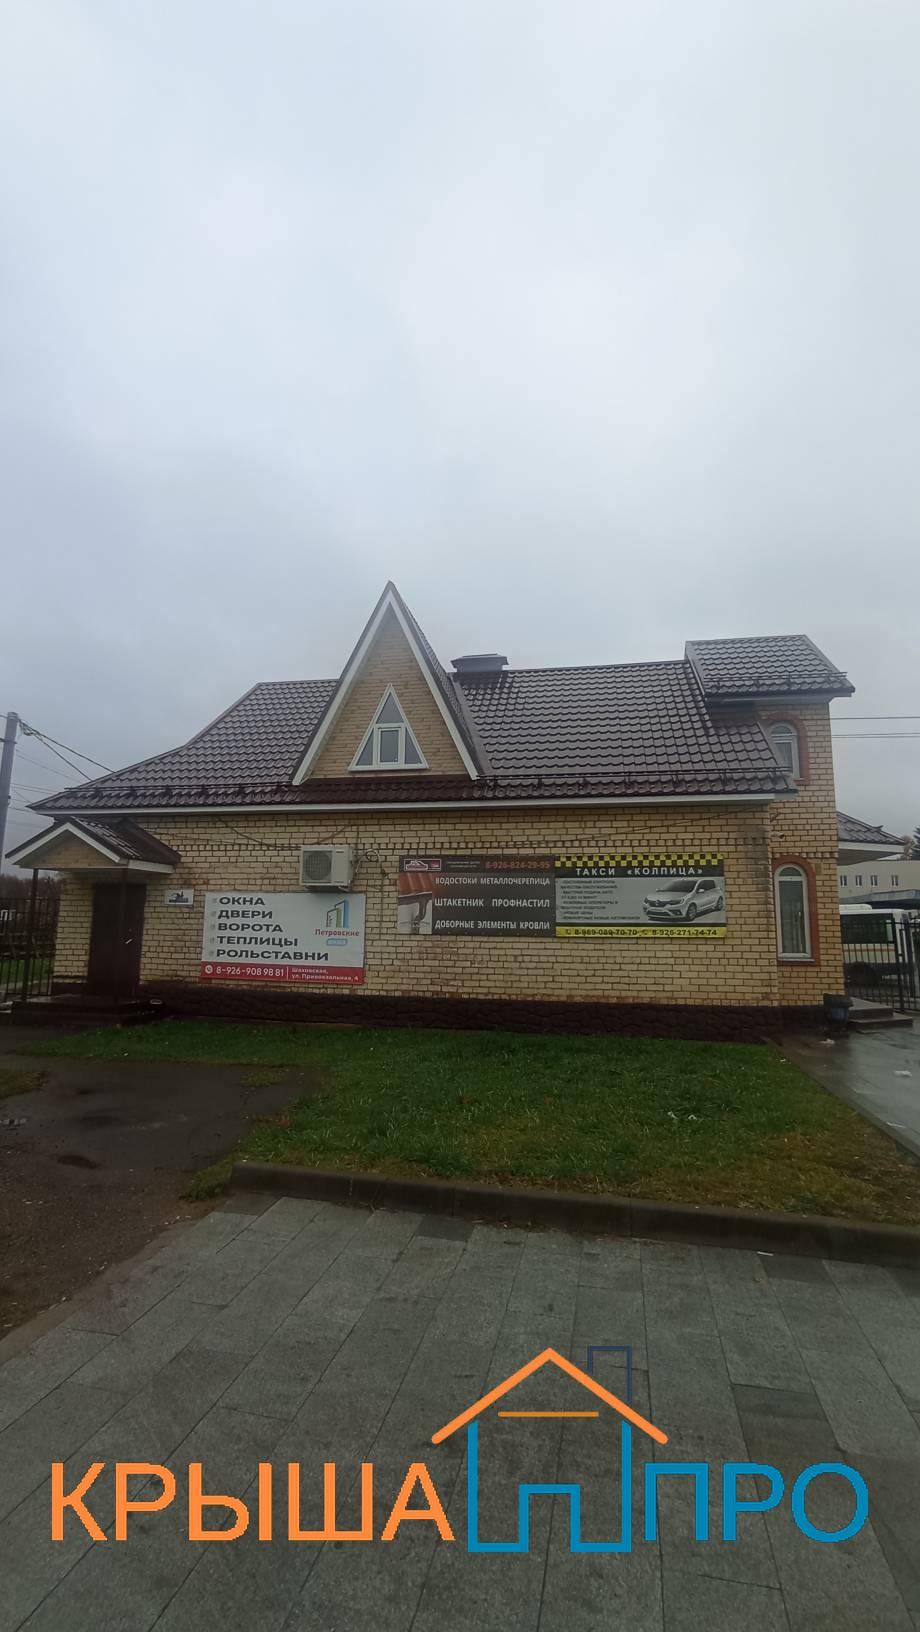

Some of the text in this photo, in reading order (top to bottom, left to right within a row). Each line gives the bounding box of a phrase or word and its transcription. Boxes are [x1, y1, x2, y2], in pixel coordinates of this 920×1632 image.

[575, 866, 704, 877] ТАКСИ «КОЛПИЦА»
[435, 877, 550, 886] ВОДОСТОКИ МЕТАЛЛОЧЕРЕПИЦА
[218, 896, 266, 906] ОКНА
[434, 898, 485, 907] ШТАКЕТНИК
[491, 899, 550, 908] ПРОФНАСТИЛ
[217, 909, 273, 920] ДВЕРИ
[217, 922, 284, 933] ВОРОТА
[434, 919, 550, 930] ДОБОРНЫЕ ЭЛЕМЕНТЫ КРОВЛИ
[315, 928, 360, 938] Петровские
[216, 935, 298, 948] ТЕПЛИЦЫ
[216, 948, 329, 962] РОЛЬСТАВНИ
[216, 966, 262, 976] 8-926-908
[275, 968, 284, 977] 81
